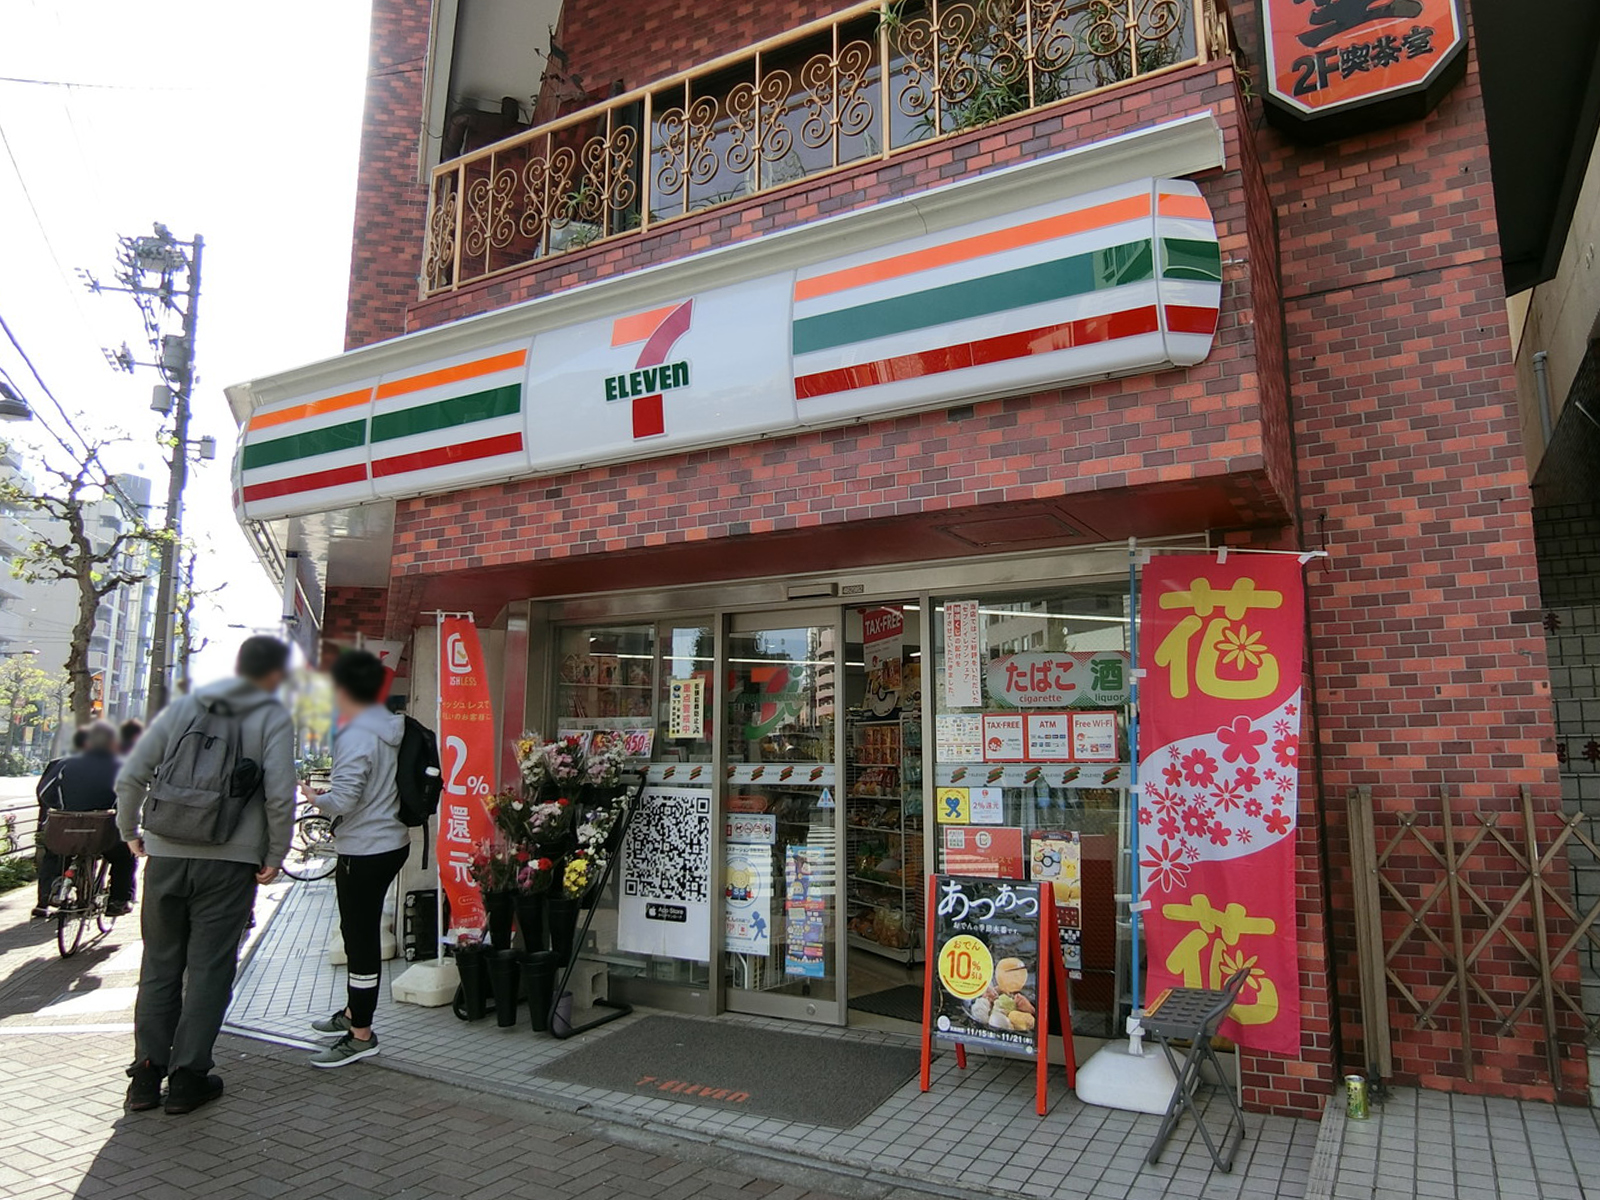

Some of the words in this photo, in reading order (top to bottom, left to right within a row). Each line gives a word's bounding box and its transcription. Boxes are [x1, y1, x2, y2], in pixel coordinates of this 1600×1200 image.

[1155, 577, 1283, 700] 花
[1005, 660, 1076, 693] たばこ
[1091, 659, 1123, 691] 酒
[1019, 693, 1063, 705] cigarette
[1094, 692, 1125, 703] liquor
[1039, 720, 1057, 728] ATM
[1075, 720, 1092, 728] Free
[1093, 719, 1113, 728] Wi-Fi
[446, 735, 490, 795] 2%
[446, 805, 477, 887] 還元
[954, 940, 980, 951] おでん
